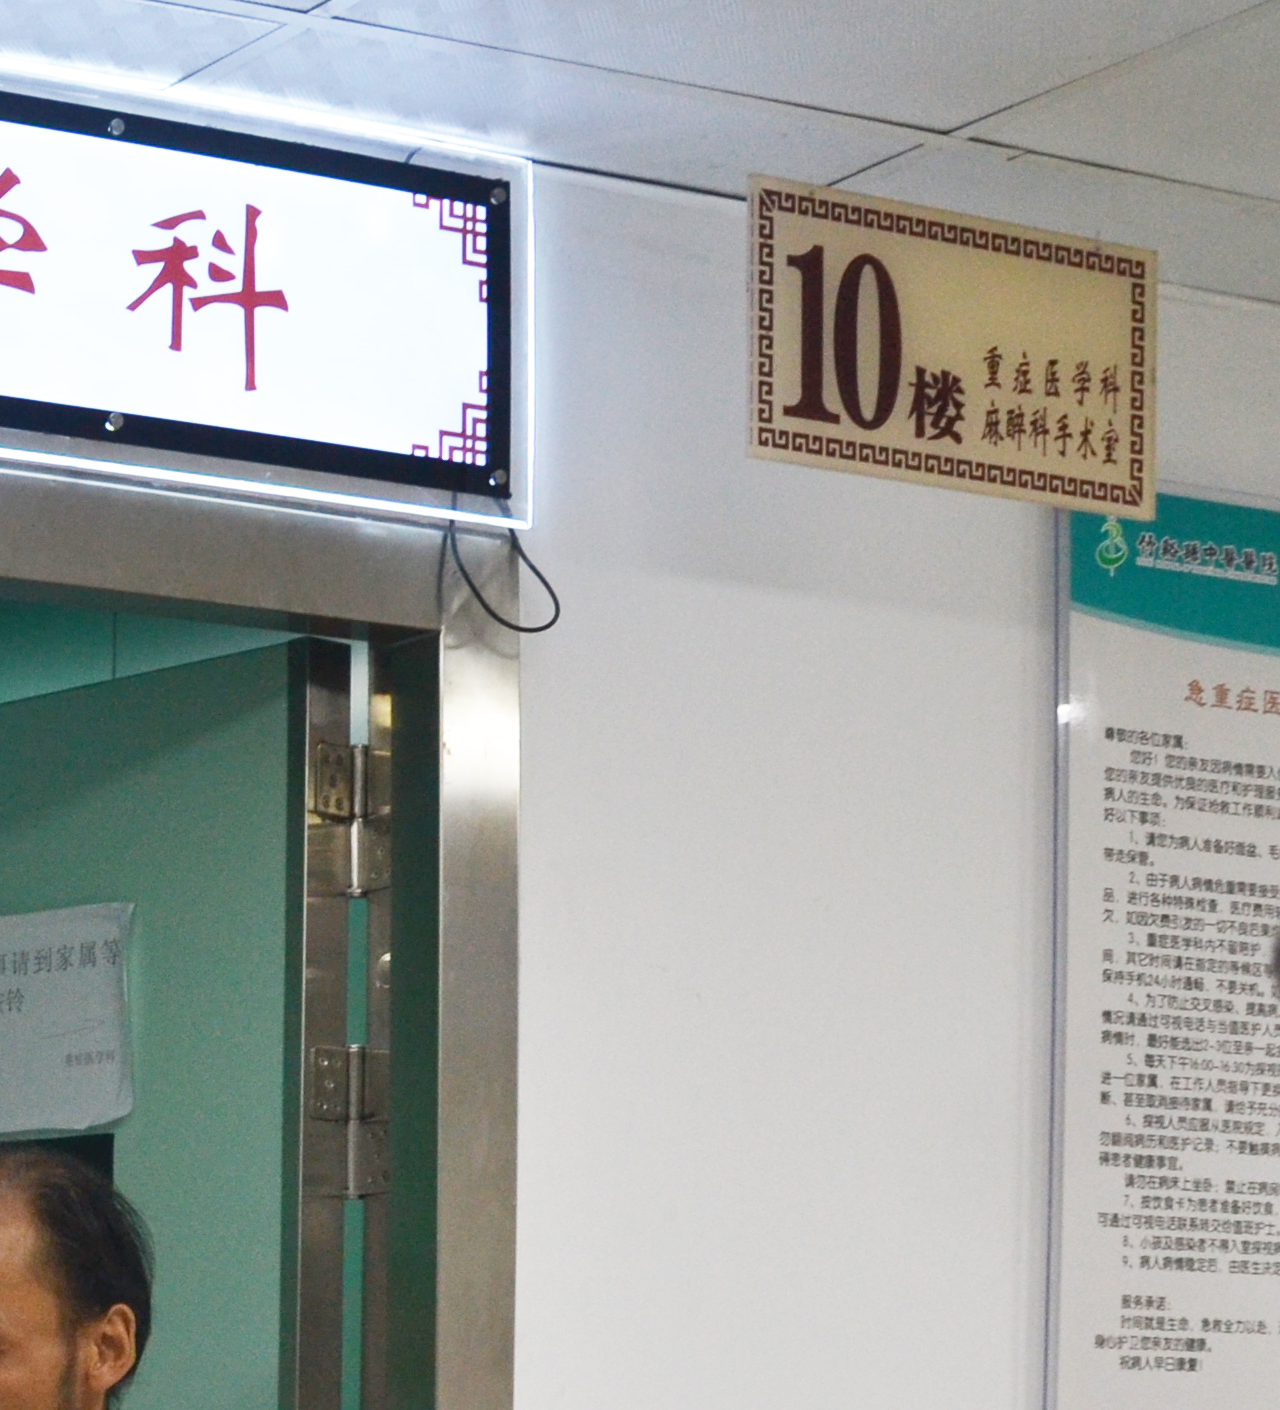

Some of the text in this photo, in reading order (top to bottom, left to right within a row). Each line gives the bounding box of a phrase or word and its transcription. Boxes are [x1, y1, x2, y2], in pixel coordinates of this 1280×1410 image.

[783, 243, 966, 445] 10楼
[983, 345, 1122, 415] 重症医学科
[980, 401, 1120, 466] 麻醉科手术室
